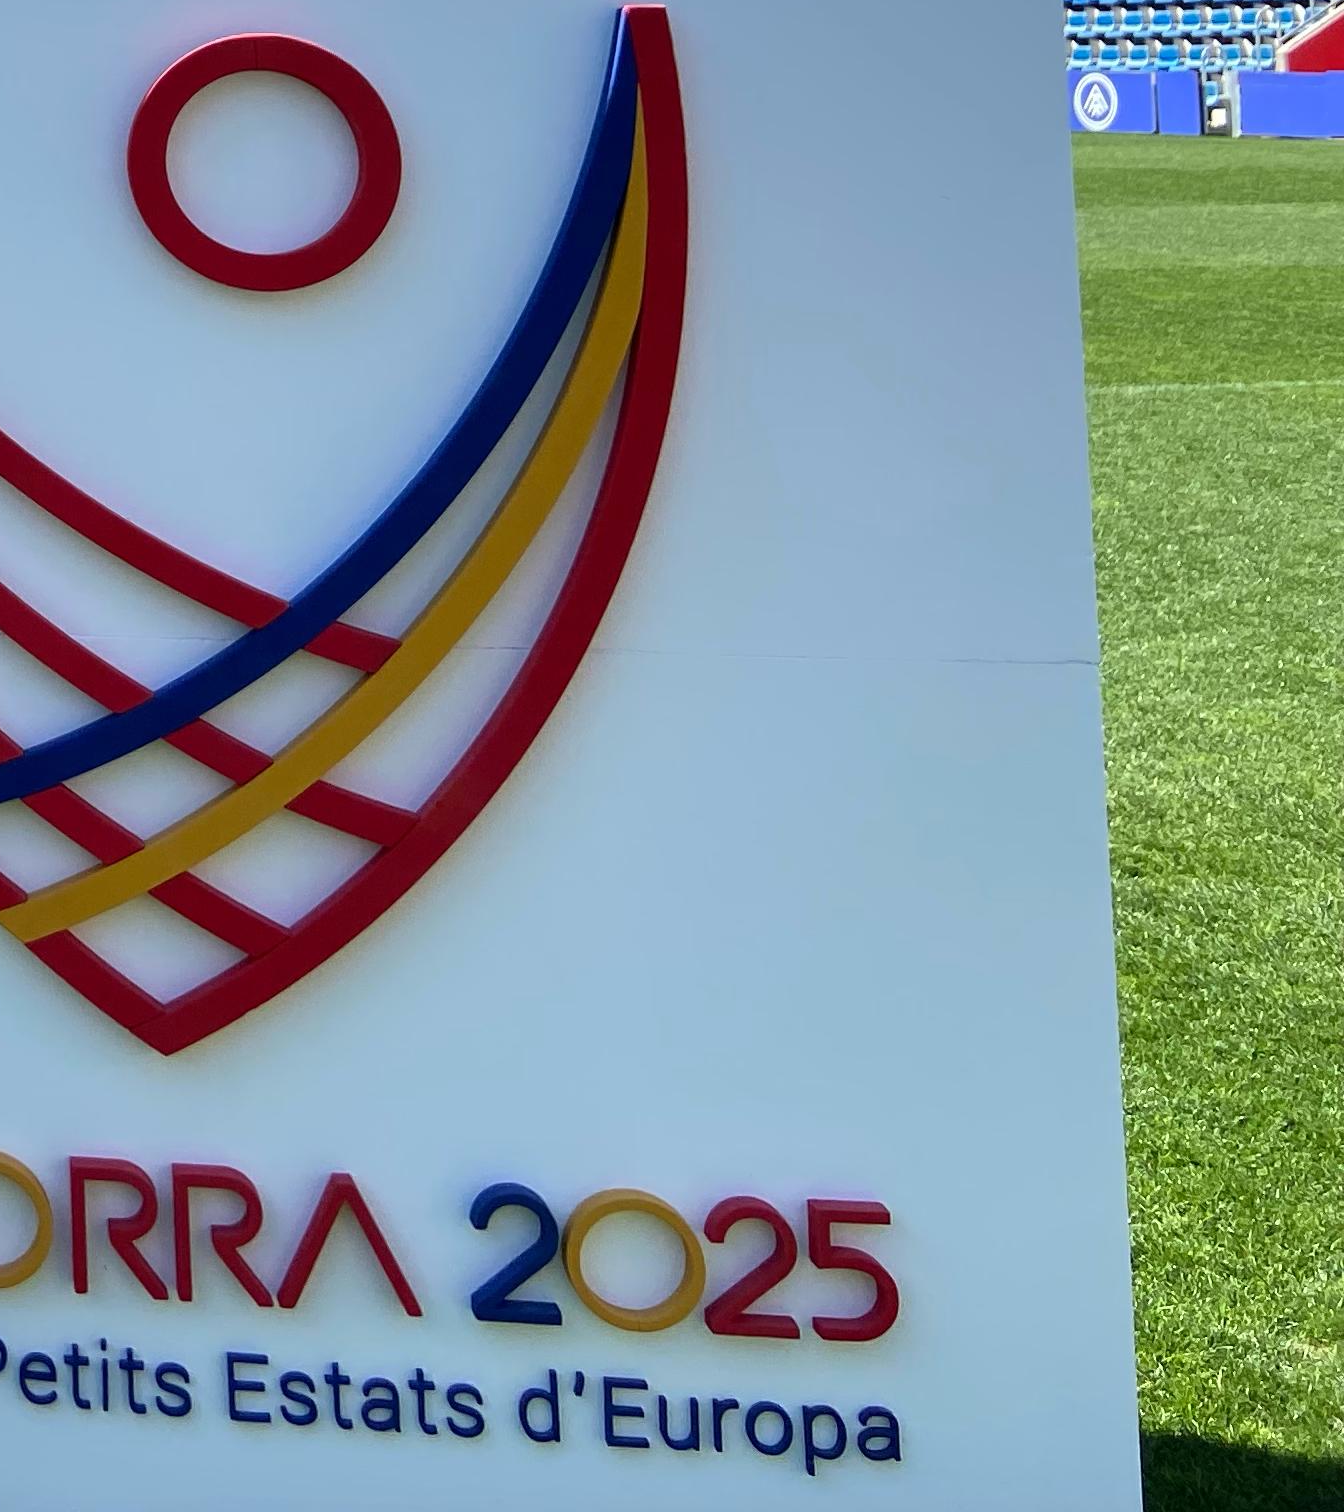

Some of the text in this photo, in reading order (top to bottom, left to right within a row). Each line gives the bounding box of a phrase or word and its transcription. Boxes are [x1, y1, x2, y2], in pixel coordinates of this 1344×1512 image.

[468, 1182, 900, 1343] 2025
[225, 1351, 485, 1438] Estats
[518, 1368, 902, 1477] d'Europa
